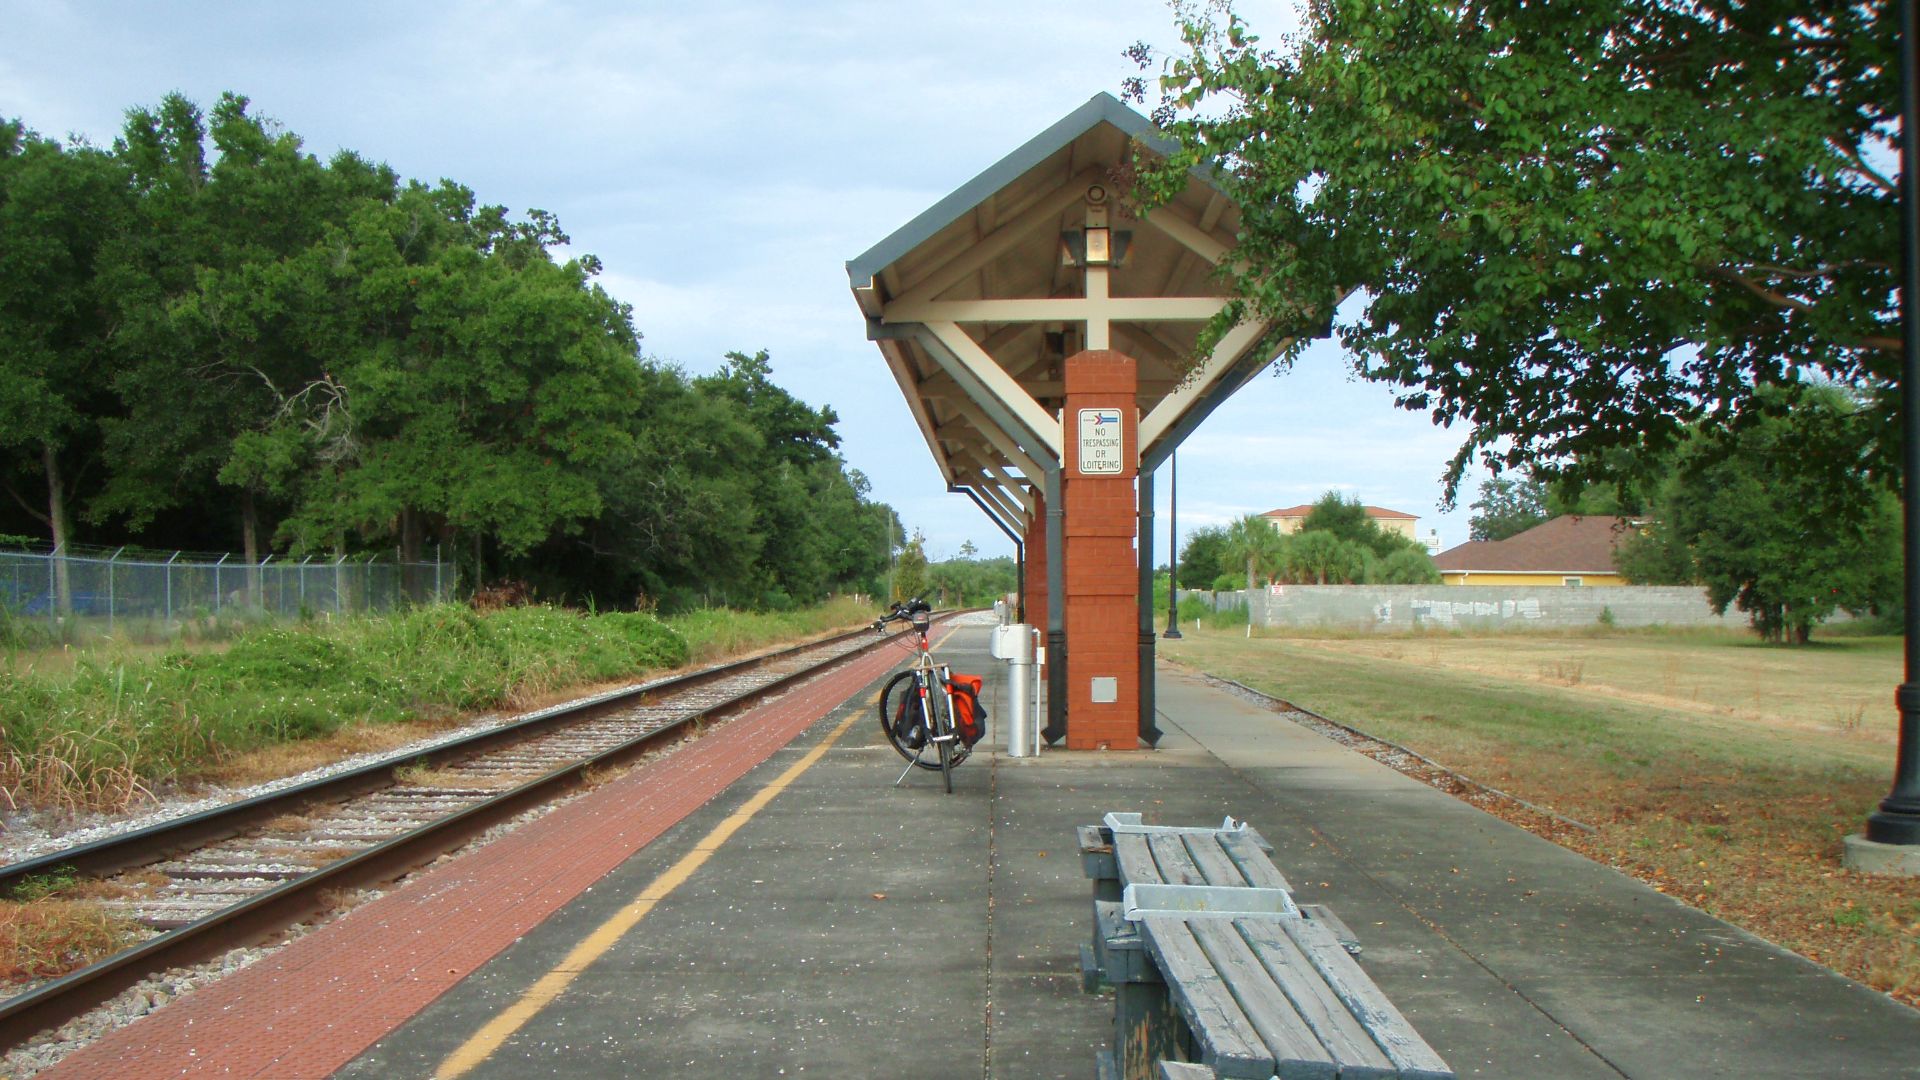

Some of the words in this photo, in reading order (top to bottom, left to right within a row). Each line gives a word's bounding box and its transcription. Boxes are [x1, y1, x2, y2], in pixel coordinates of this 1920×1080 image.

[1095, 428, 1106, 436] NO
[1083, 439, 1119, 447] TRESPASSING
[1095, 450, 1106, 458] OR
[1083, 461, 1119, 469] LOITERING
